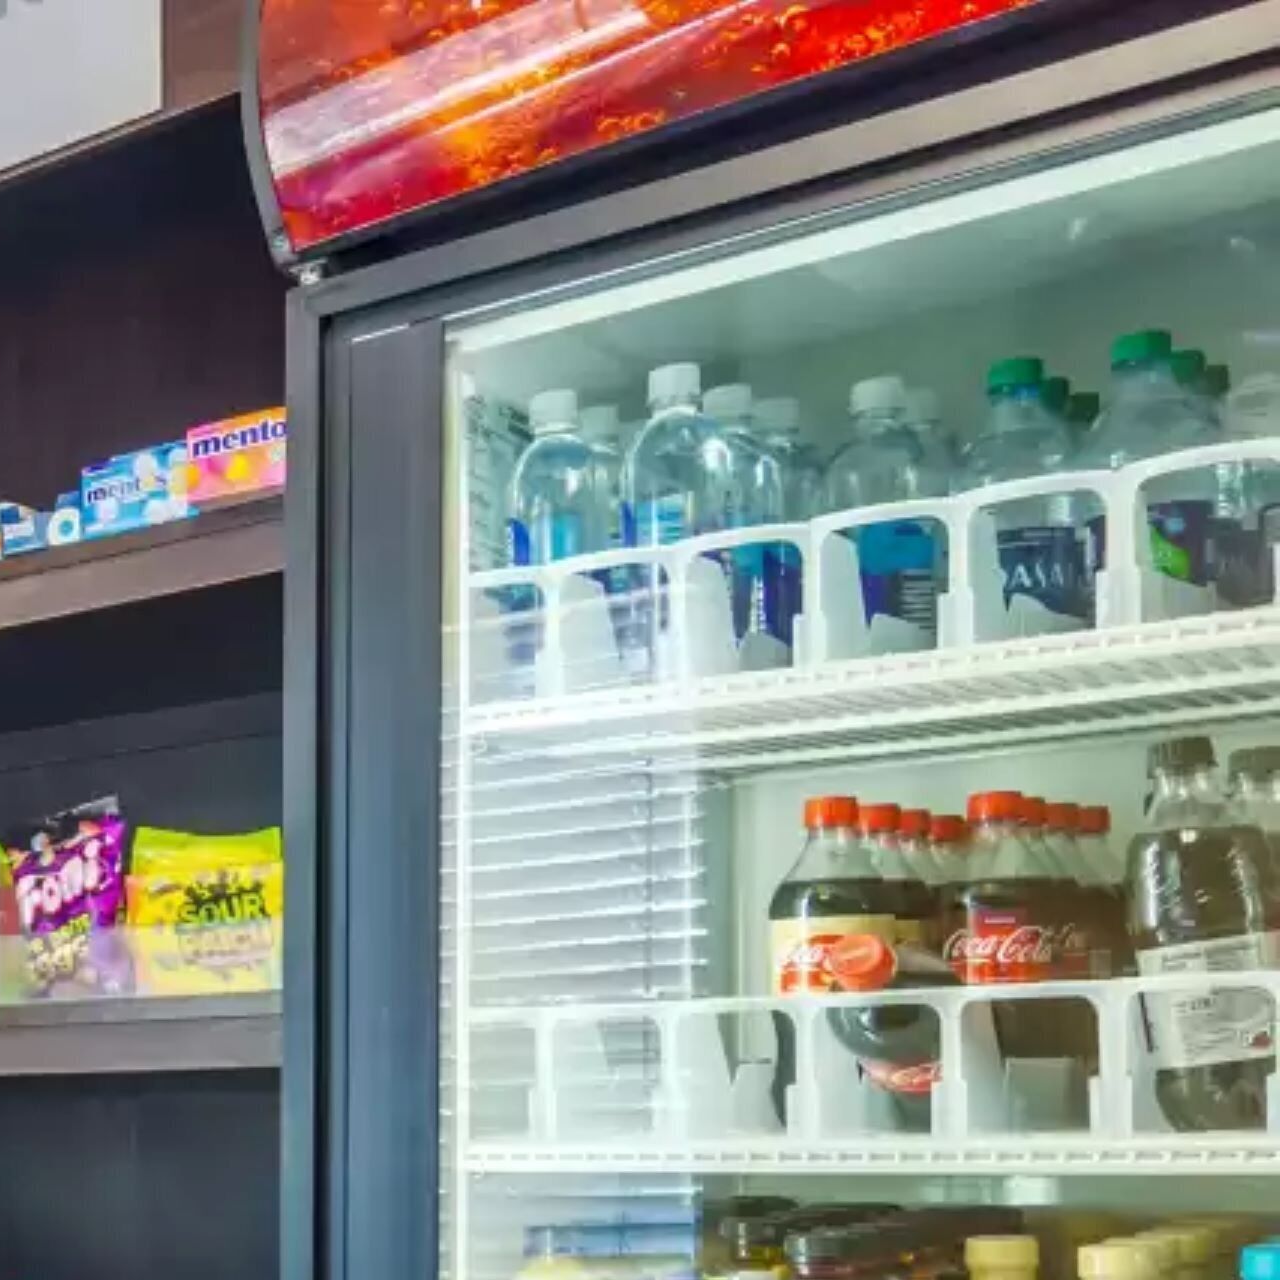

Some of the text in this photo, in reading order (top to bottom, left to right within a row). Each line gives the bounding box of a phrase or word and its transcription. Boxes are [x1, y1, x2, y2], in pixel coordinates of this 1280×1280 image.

[192, 417, 286, 459] mento
[87, 473, 167, 503] mentos
[177, 892, 267, 926] SOUR
